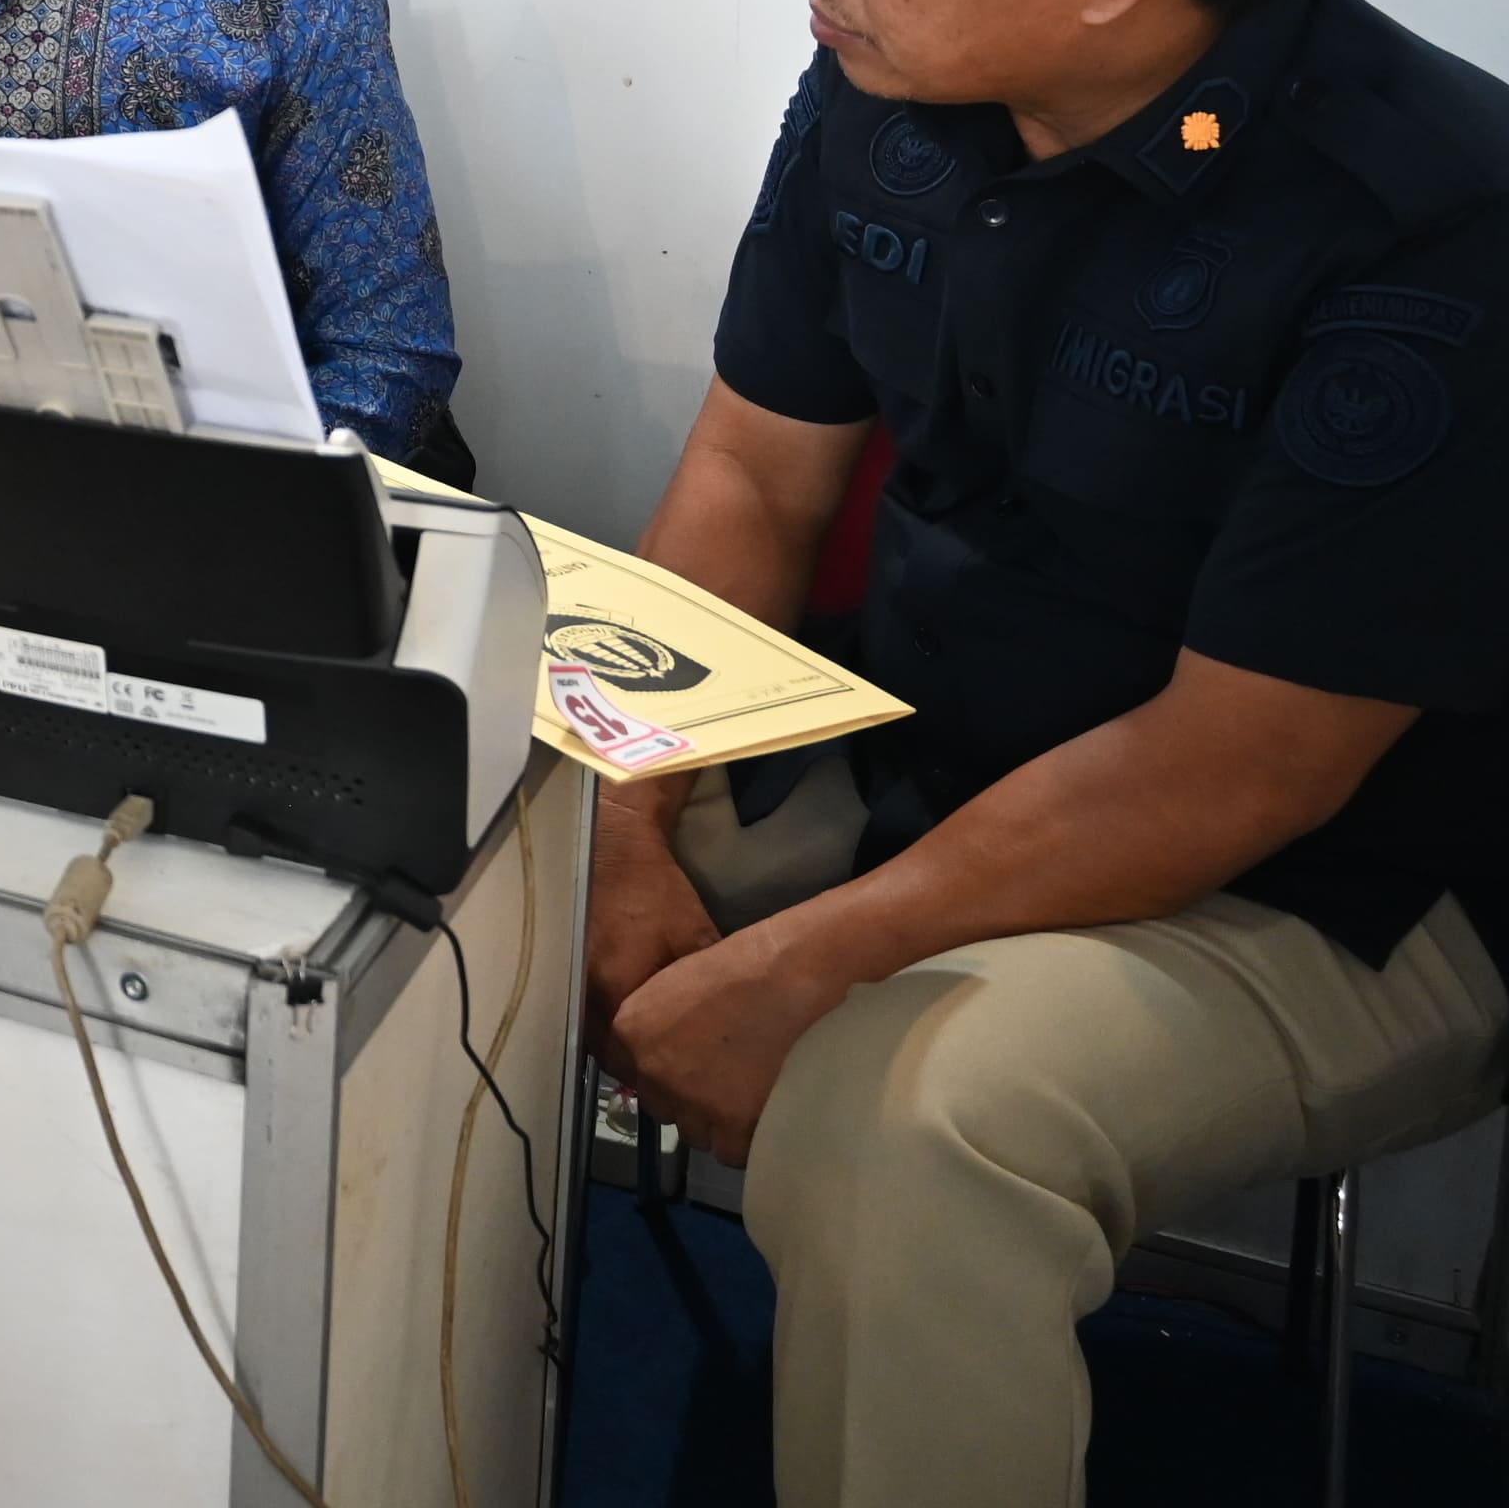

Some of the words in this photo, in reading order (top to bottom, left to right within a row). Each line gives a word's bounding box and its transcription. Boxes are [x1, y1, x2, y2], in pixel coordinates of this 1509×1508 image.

[829, 208, 929, 285] EDI
[1050, 318, 1247, 430] IMIGRASI
[565, 694, 629, 742] 15
